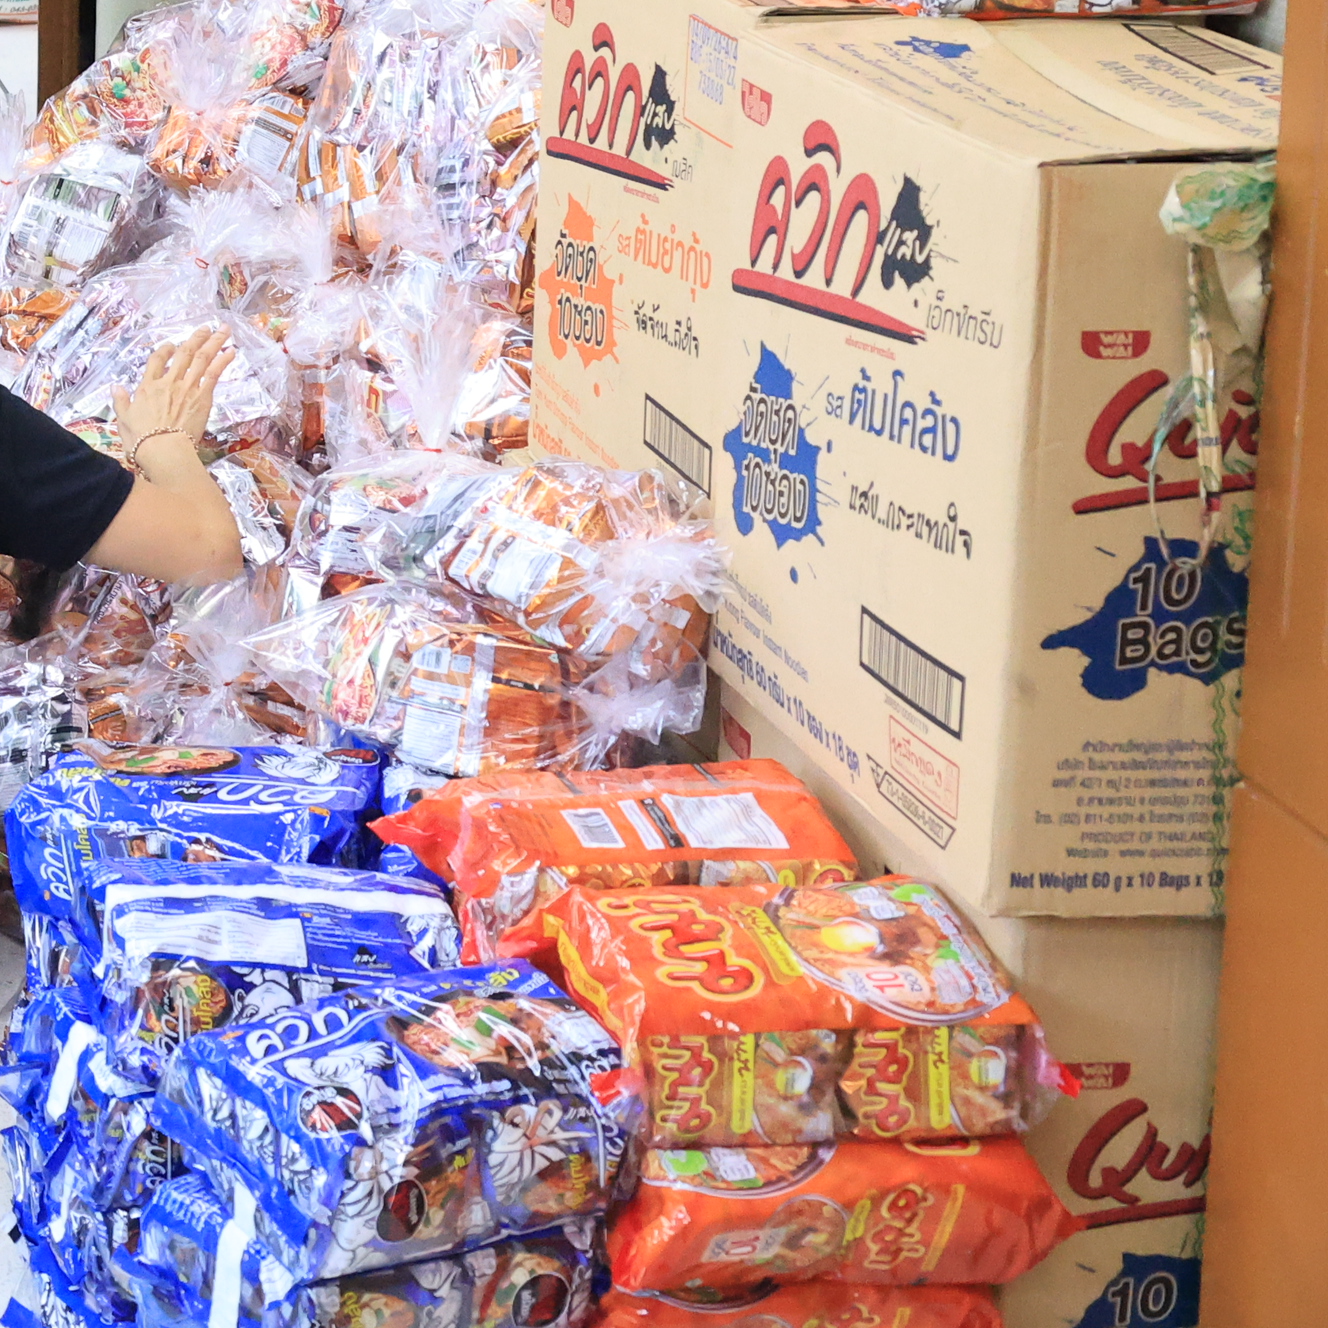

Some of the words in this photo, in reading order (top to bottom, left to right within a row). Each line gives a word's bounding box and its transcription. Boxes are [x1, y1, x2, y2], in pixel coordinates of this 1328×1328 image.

[559, 22, 643, 159] ควิก
[750, 119, 881, 300] ควิก
[554, 229, 598, 298] จัดชุด
[617, 233, 632, 257] รส
[633, 213, 712, 303] ต้มยำกุ้ง
[557, 292, 606, 348] 10ซอง
[1099, 332, 1134, 345] WAI
[1099, 345, 1134, 358] WAI
[742, 381, 799, 465] จัดชุด
[825, 391, 845, 420] รส
[847, 366, 962, 463] ต้มโคล้ง
[1085, 368, 1260, 484] Qui
[742, 453, 809, 529] 10ซอง
[1129, 558, 1202, 616] 10
[1115, 615, 1247, 671] Bags
[1010, 872, 1034, 888] Net
[1039, 872, 1088, 893] Weight
[1092, 872, 1110, 888] 60
[1139, 873, 1156, 888] 10
[1159, 872, 1191, 891] Bags
[1108, 1272, 1178, 1327] 10
